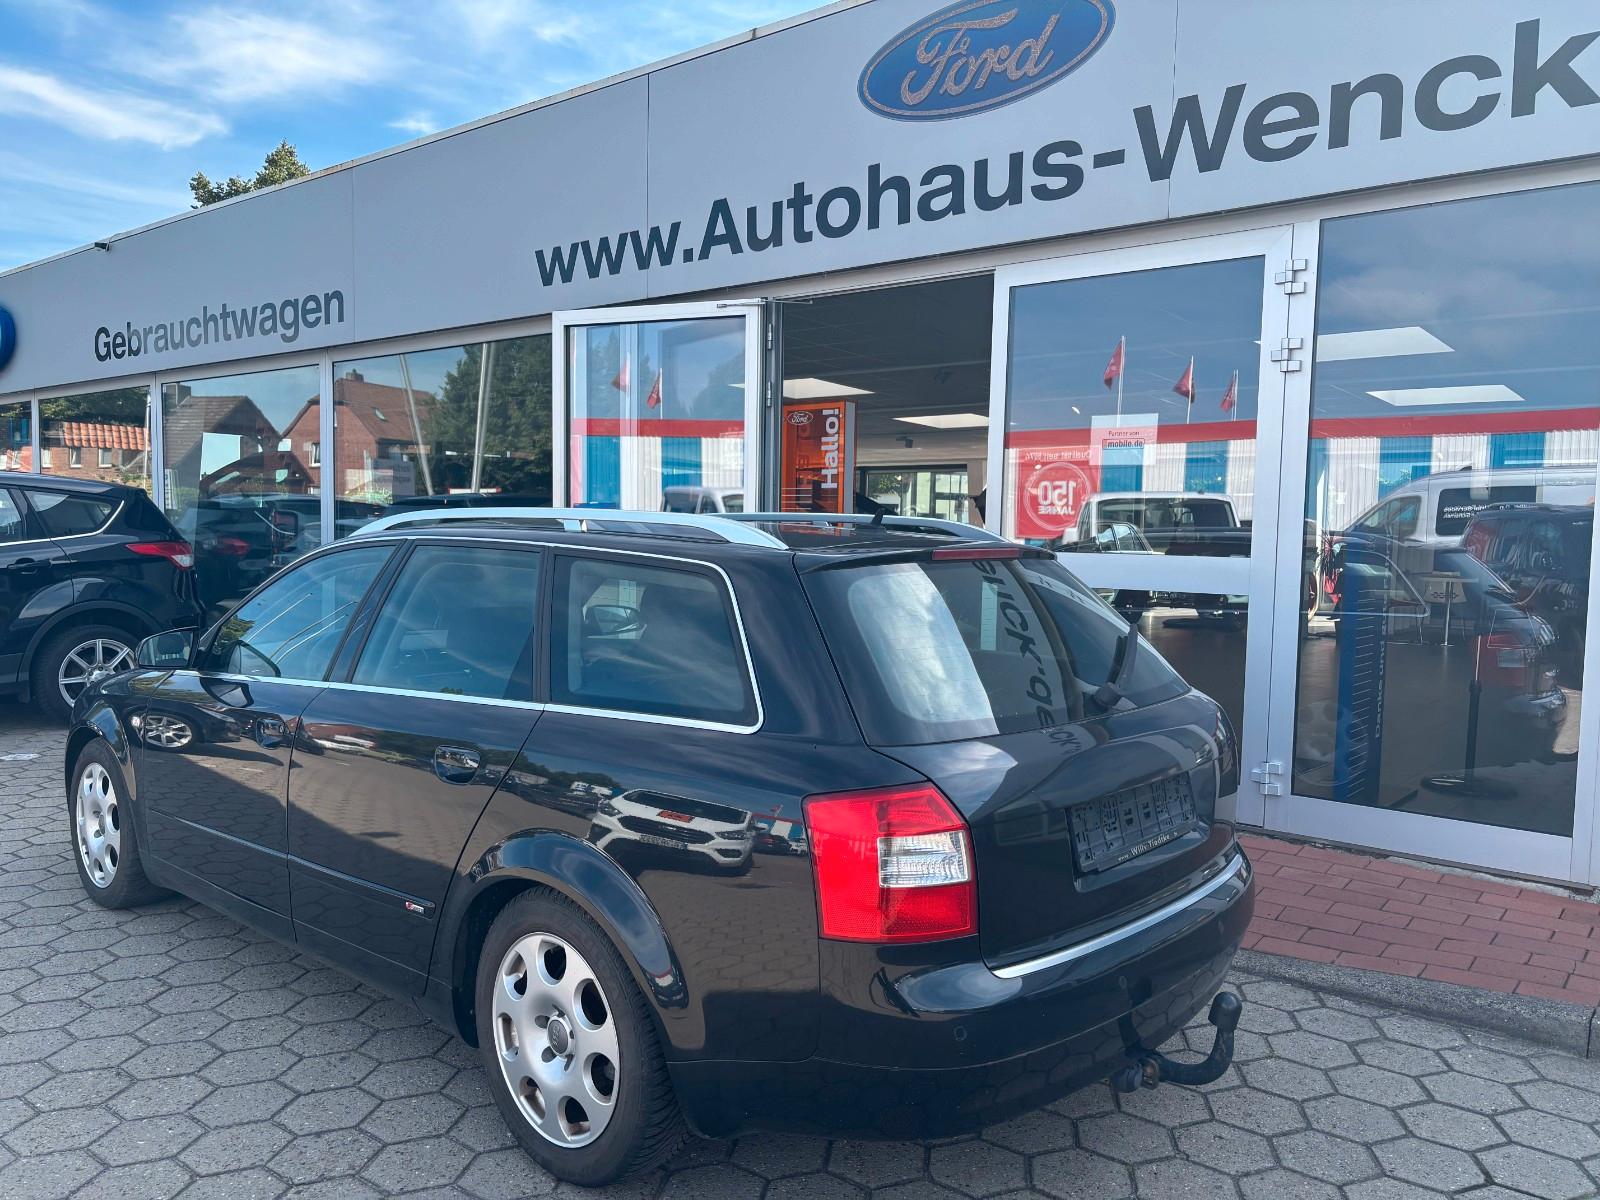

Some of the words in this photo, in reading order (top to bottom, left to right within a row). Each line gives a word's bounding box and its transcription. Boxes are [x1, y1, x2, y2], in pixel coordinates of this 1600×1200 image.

[901, 7, 1061, 106] Ford
[535, 18, 1600, 287] www.Autohaus-Wenck
[94, 289, 345, 362] Gebrauchtwagen
[791, 412, 809, 423] Ford
[821, 409, 839, 489] Hallo!
[1107, 439, 1143, 449] mobile.de
